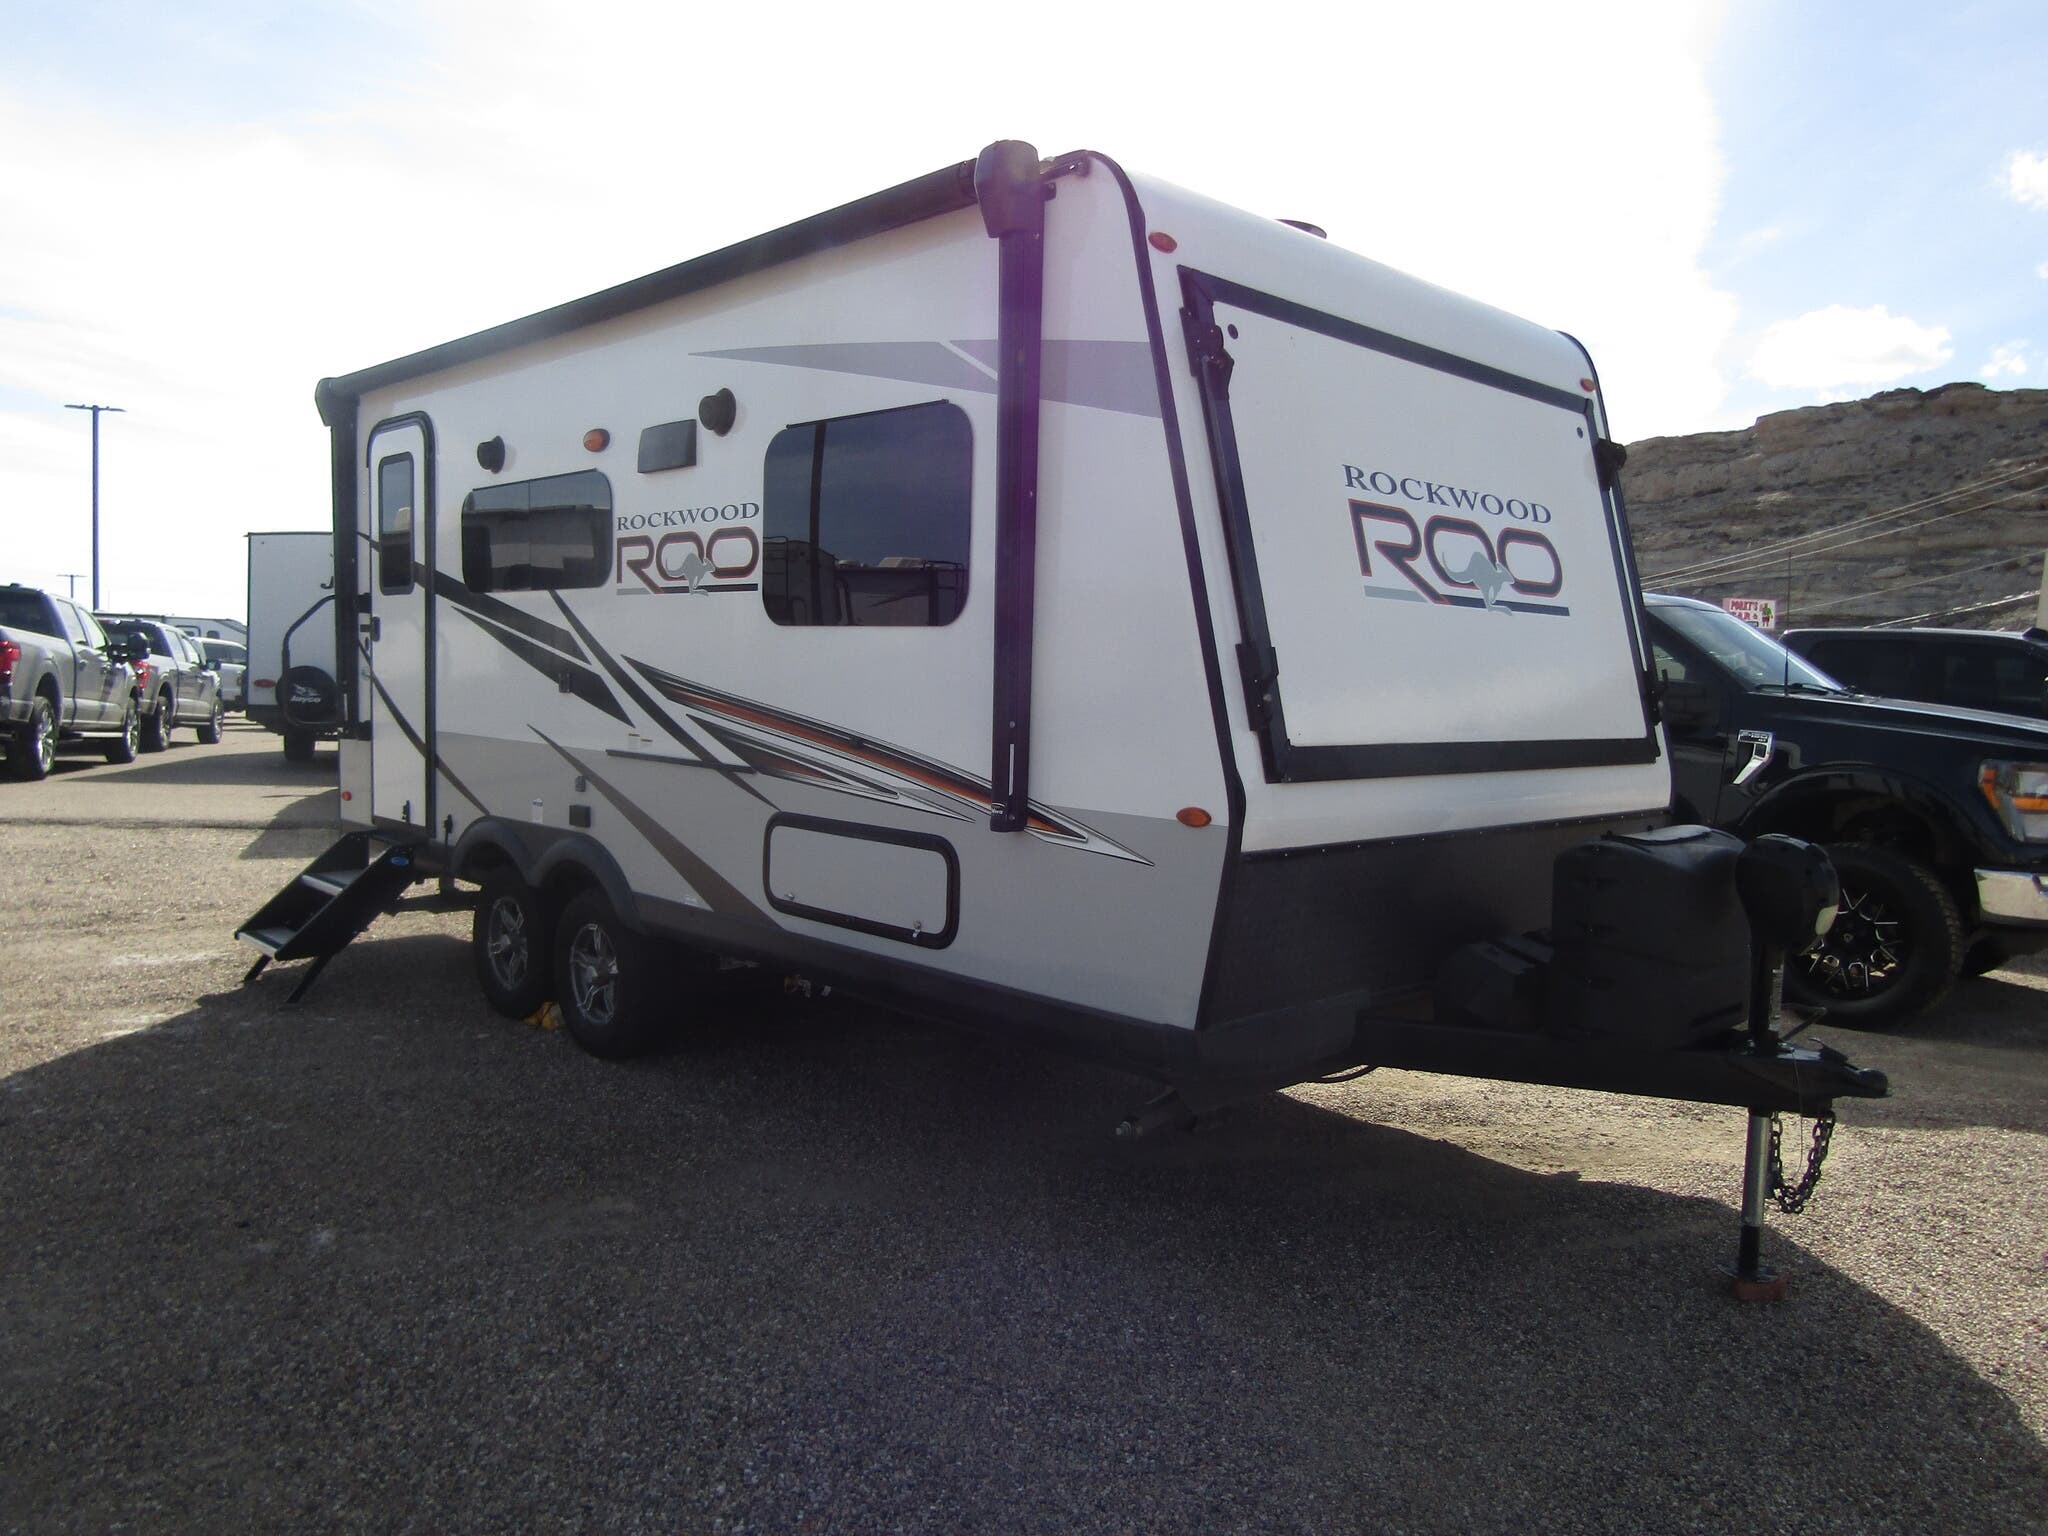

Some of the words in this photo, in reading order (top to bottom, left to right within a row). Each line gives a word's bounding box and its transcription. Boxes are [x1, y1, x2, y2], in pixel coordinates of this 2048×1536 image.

[616, 502, 760, 531] ROCKWOOD
[1342, 464, 1552, 524] ROCKWOOD
[616, 526, 760, 594] ROO
[1347, 498, 1563, 606] ROO
